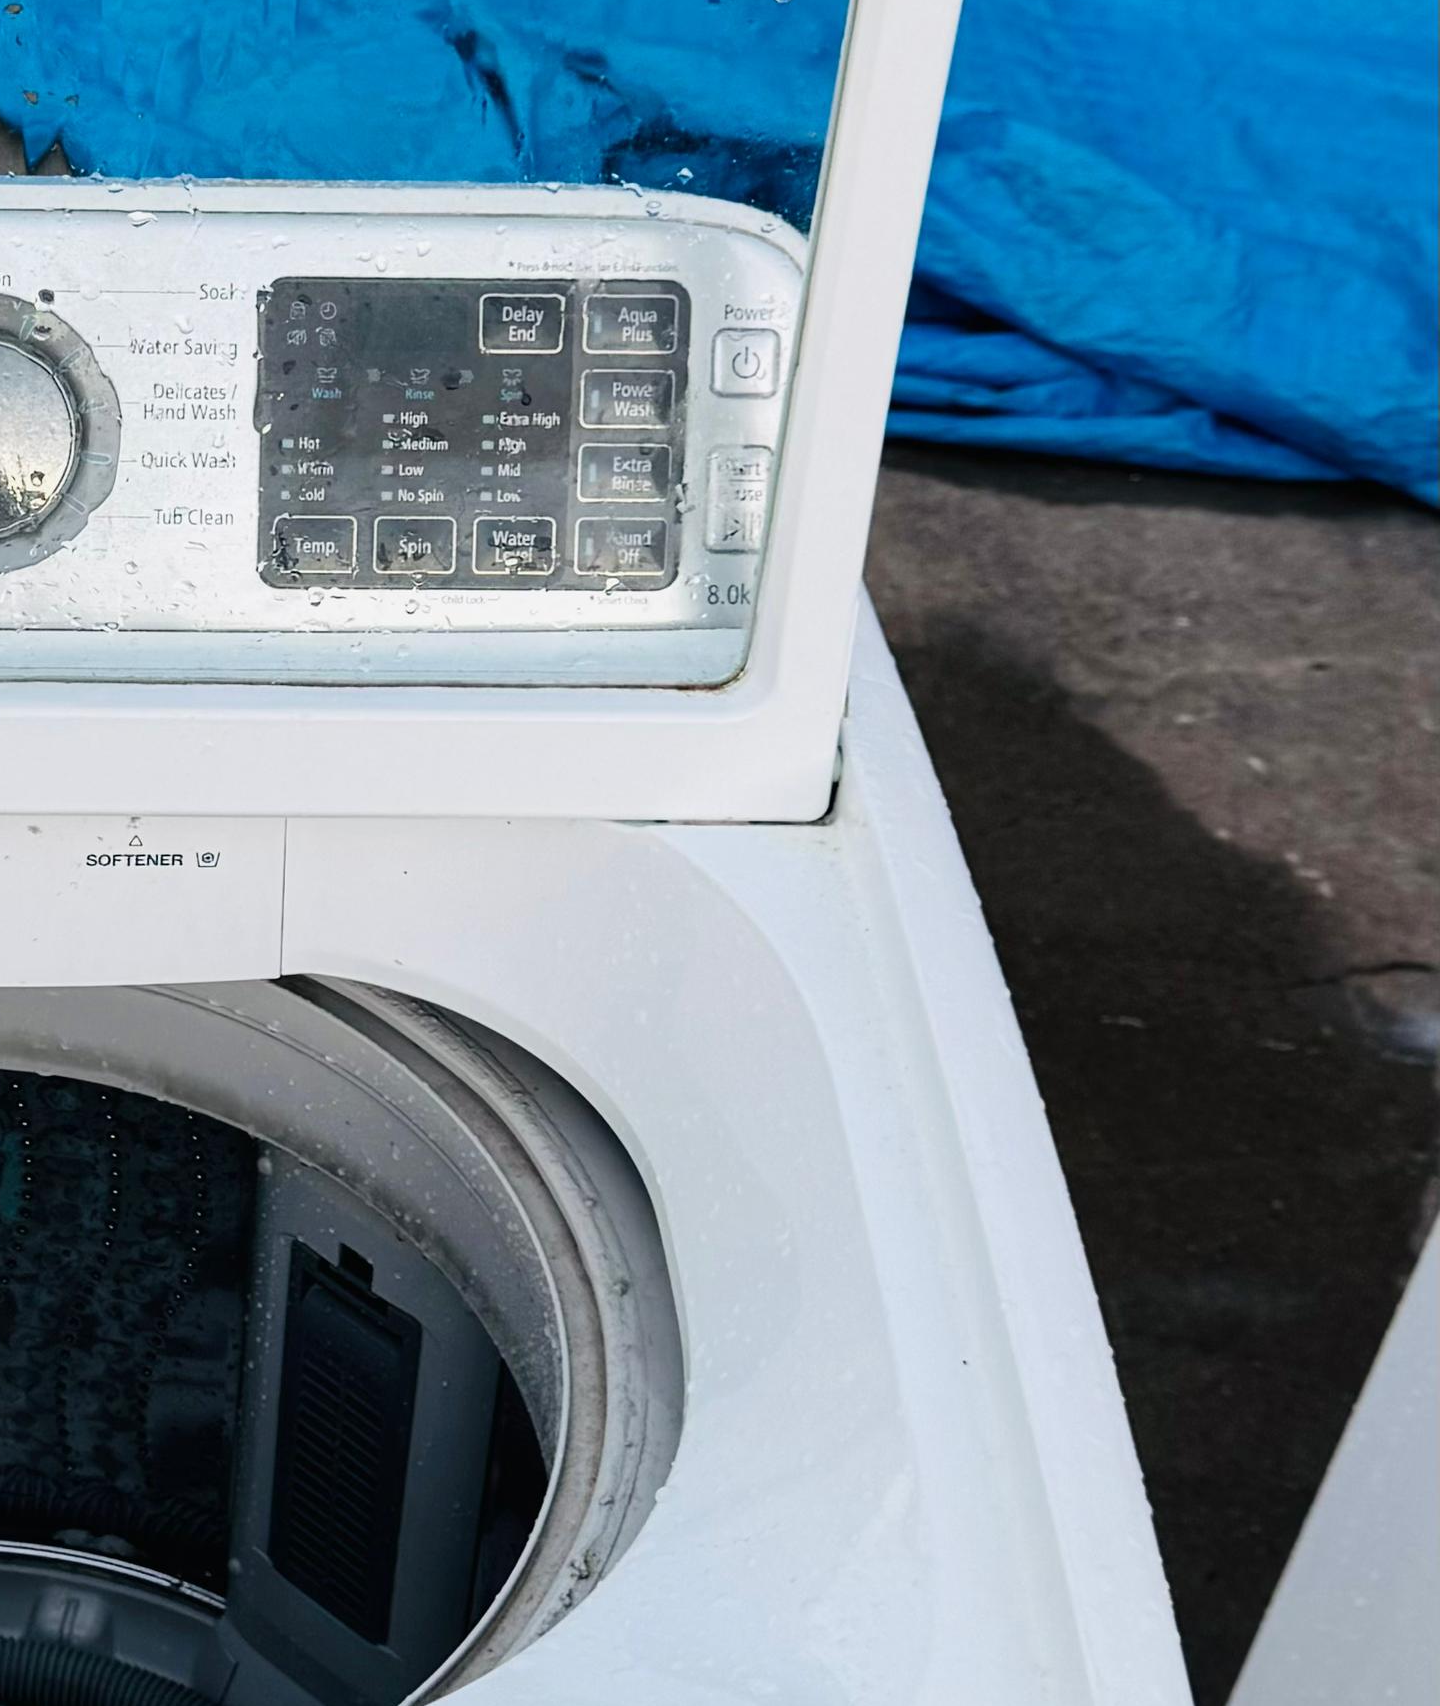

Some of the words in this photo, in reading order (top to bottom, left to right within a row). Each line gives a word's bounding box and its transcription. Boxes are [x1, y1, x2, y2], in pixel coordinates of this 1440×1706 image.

[501, 306, 544, 327] Delay
[618, 307, 658, 328] Aqua
[508, 325, 536, 342] End
[621, 325, 653, 342] Plus
[183, 338, 238, 360] Savig
[311, 388, 342, 400] Wash
[404, 388, 435, 400] Rinse
[612, 381, 655, 398] Powe
[143, 403, 186, 420] Hand
[191, 403, 237, 420] Wash
[614, 400, 655, 417] Wash
[399, 411, 428, 429] High
[532, 411, 561, 429] High
[298, 436, 320, 451] Hot
[141, 451, 187, 470] Quick
[191, 452, 237, 469] Wash
[612, 456, 653, 473] Extra
[398, 463, 424, 477] Low
[497, 462, 521, 477] Mid
[298, 487, 325, 502] Cold
[397, 488, 416, 502] No
[417, 488, 445, 505] Spin
[153, 507, 184, 525] Tub
[187, 507, 234, 525] Clean
[492, 530, 537, 546] Water
[294, 538, 339, 559] Temp.
[398, 538, 432, 559] Spin
[85, 852, 184, 868] SOFTENER
